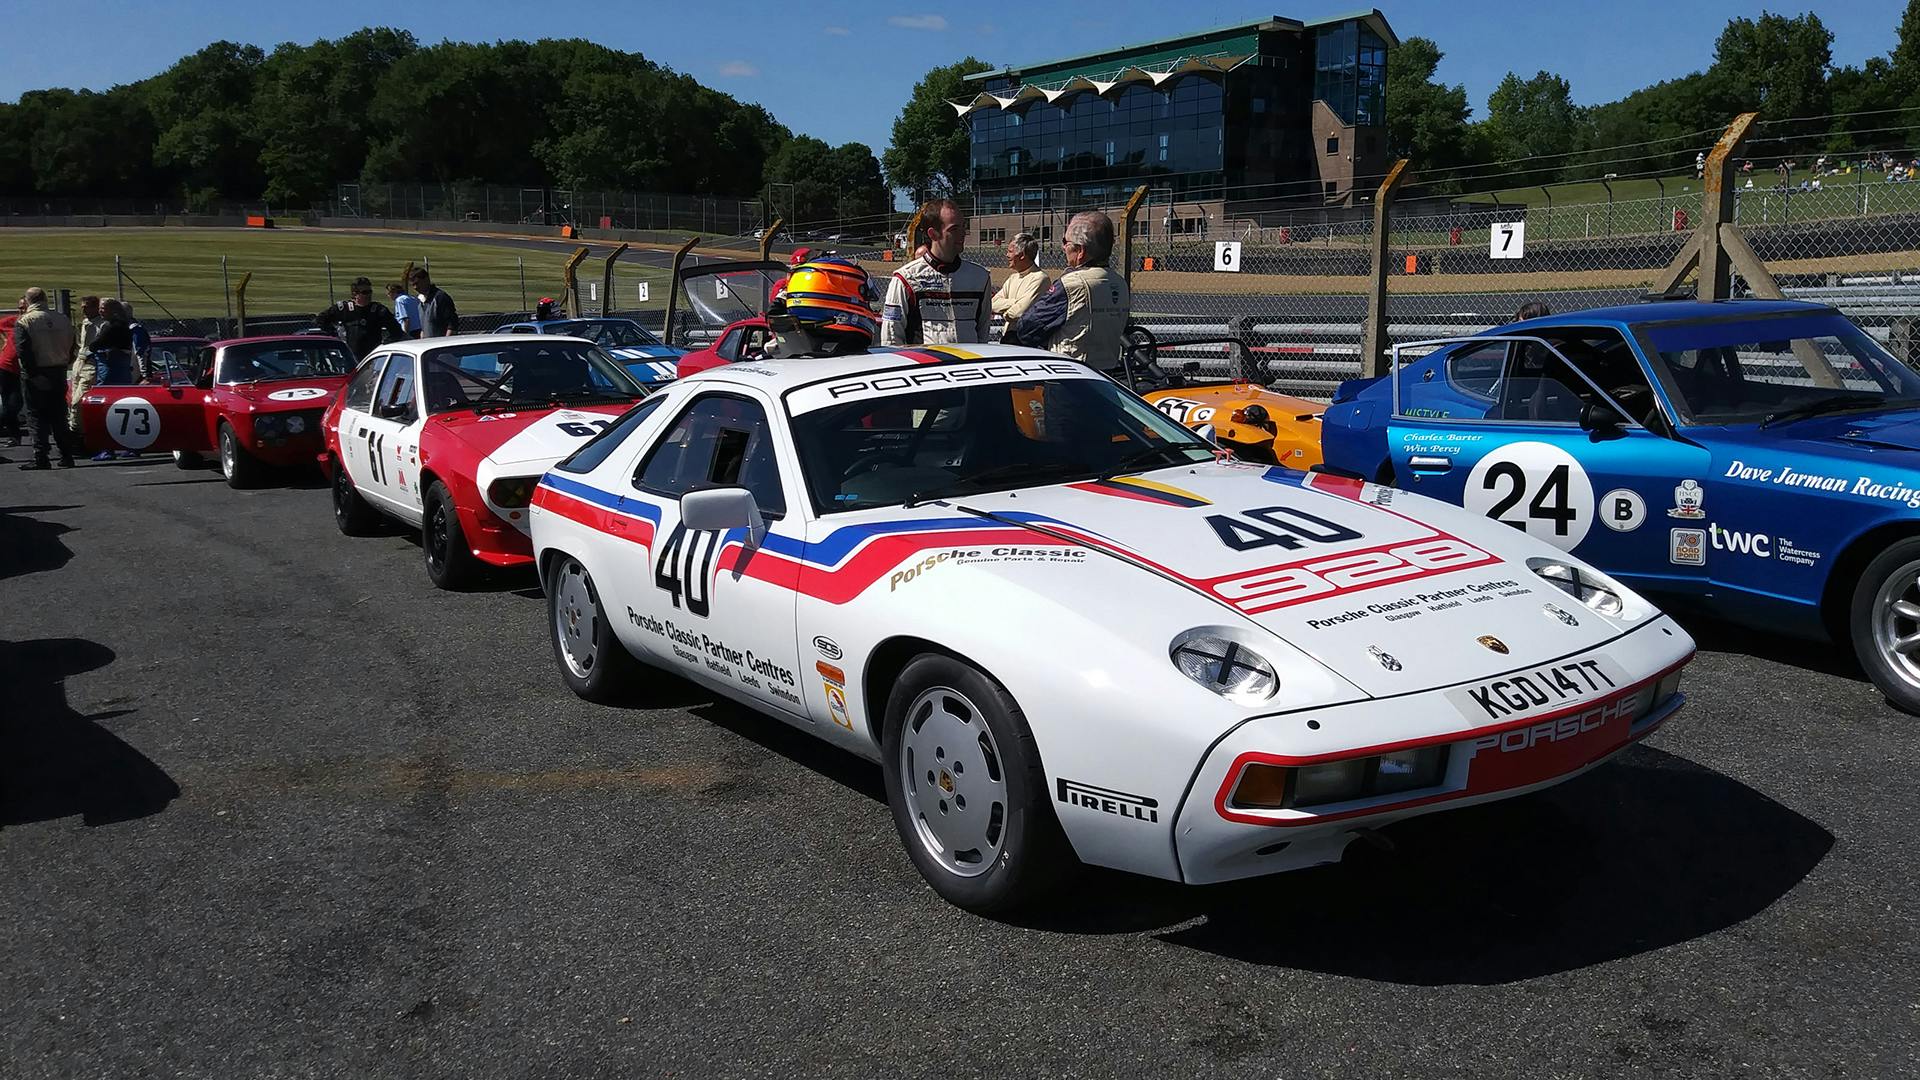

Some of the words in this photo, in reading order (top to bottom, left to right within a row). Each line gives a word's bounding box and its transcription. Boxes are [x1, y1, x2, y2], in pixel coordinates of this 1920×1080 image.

[1222, 247, 1232, 266] 6
[1501, 230, 1513, 251] 7
[641, 286, 647, 298] 2
[719, 281, 725, 295] 3
[282, 388, 314, 398] 73
[827, 364, 1082, 399] PORSCHE
[114, 408, 149, 435] 73
[1198, 409, 1210, 420] C
[1403, 433, 1443, 442] Charles
[1445, 433, 1483, 441] Barter
[1403, 443, 1427, 453] Win
[1429, 445, 1461, 455] Percy
[369, 430, 388, 487] 61
[1482, 461, 1577, 536] 24
[1725, 460, 1772, 482] Dave
[1773, 467, 1848, 493] Jarman
[1850, 476, 1920, 509] Racing
[1614, 498, 1633, 521] B
[1205, 506, 1364, 552] 40
[1709, 522, 1771, 558] twc
[1778, 537, 1793, 547] The
[956, 557, 1000, 565] Genuine
[1676, 546, 1700, 554] ROAD
[1779, 545, 1821, 559] Watercress
[1779, 553, 1815, 567] Company
[655, 520, 721, 617] 40
[890, 549, 981, 592] Porsche
[991, 547, 1087, 558] Classic
[1212, 540, 1493, 612] 928
[1307, 605, 1370, 630] Porsche
[1367, 596, 1420, 616] Classic
[1415, 586, 1468, 604] Partner
[1467, 578, 1520, 594] Centres
[1385, 609, 1422, 623] Glasgow
[1427, 599, 1463, 612] Hatfield
[1467, 594, 1494, 604] Leeds
[1499, 587, 1533, 599] Swindon
[627, 605, 666, 637] Porsche
[665, 620, 702, 652] Classic
[702, 633, 744, 668] Partner
[746, 650, 796, 687] Centres
[672, 643, 700, 665] Glasgow
[704, 656, 733, 678] Hatfield
[738, 670, 761, 689] Leeds
[768, 681, 802, 706] Swindon
[1468, 675, 1552, 720] KGD
[1536, 659, 1617, 699] 147T
[1473, 696, 1637, 753] PORSCHE
[1056, 777, 1159, 824] PIRELLI
